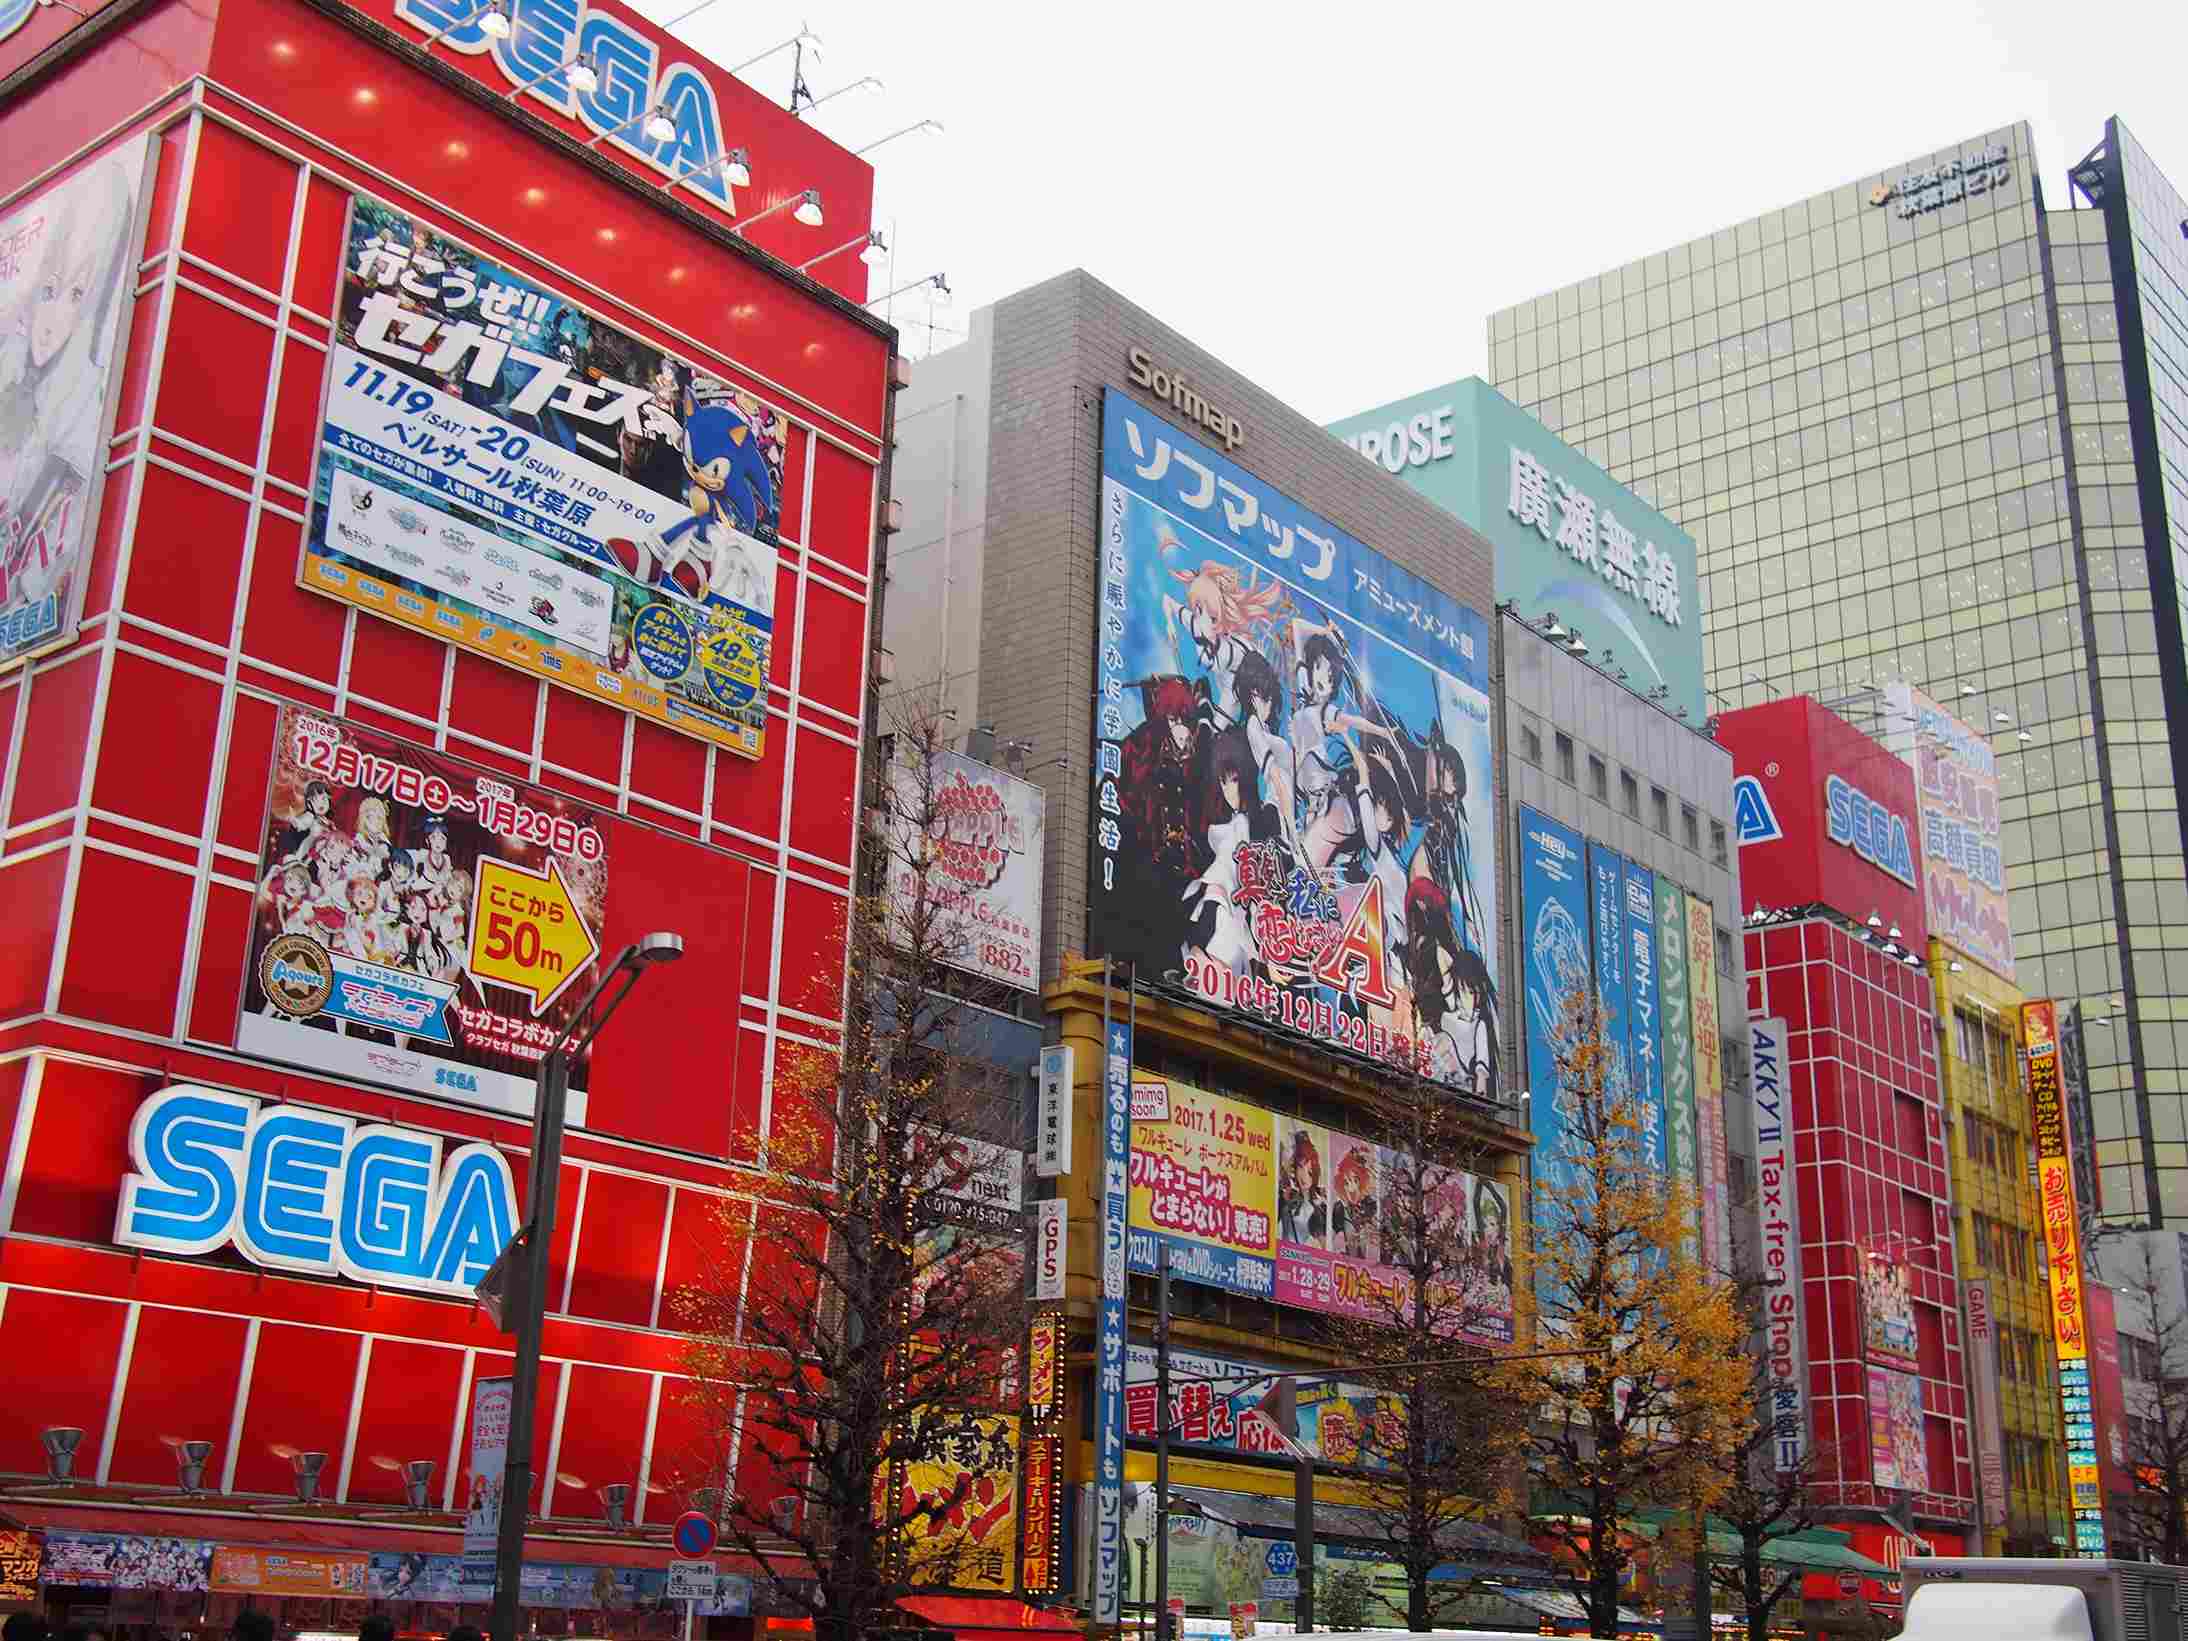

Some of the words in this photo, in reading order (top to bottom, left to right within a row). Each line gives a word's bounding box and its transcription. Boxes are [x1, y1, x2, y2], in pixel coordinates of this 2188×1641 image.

[353, 291, 660, 442] セガフェス
[1127, 346, 1243, 450] Sofmap
[383, 422, 597, 527] ベルサール秋葉原
[1125, 417, 1336, 581] ソフマップ
[1826, 774, 1916, 890] SEGA
[483, 913, 563, 974] 50m
[489, 883, 566, 921] ここから
[433, 1066, 481, 1093] SEGA
[1752, 1028, 1780, 1121] AKKY
[1174, 1105, 1245, 1144] 2017.1.25
[1247, 1131, 1271, 1152] wed
[112, 1082, 523, 1300] SEGA
[1044, 1218, 1060, 1278] GPS
[1967, 1287, 1988, 1340] GAME
[1032, 1403, 1051, 1418] 1F
[1101, 1332, 1122, 1480] サポートも
[1097, 1491, 1120, 1615] ソフマップ
[1266, 1552, 1294, 1566] 437
